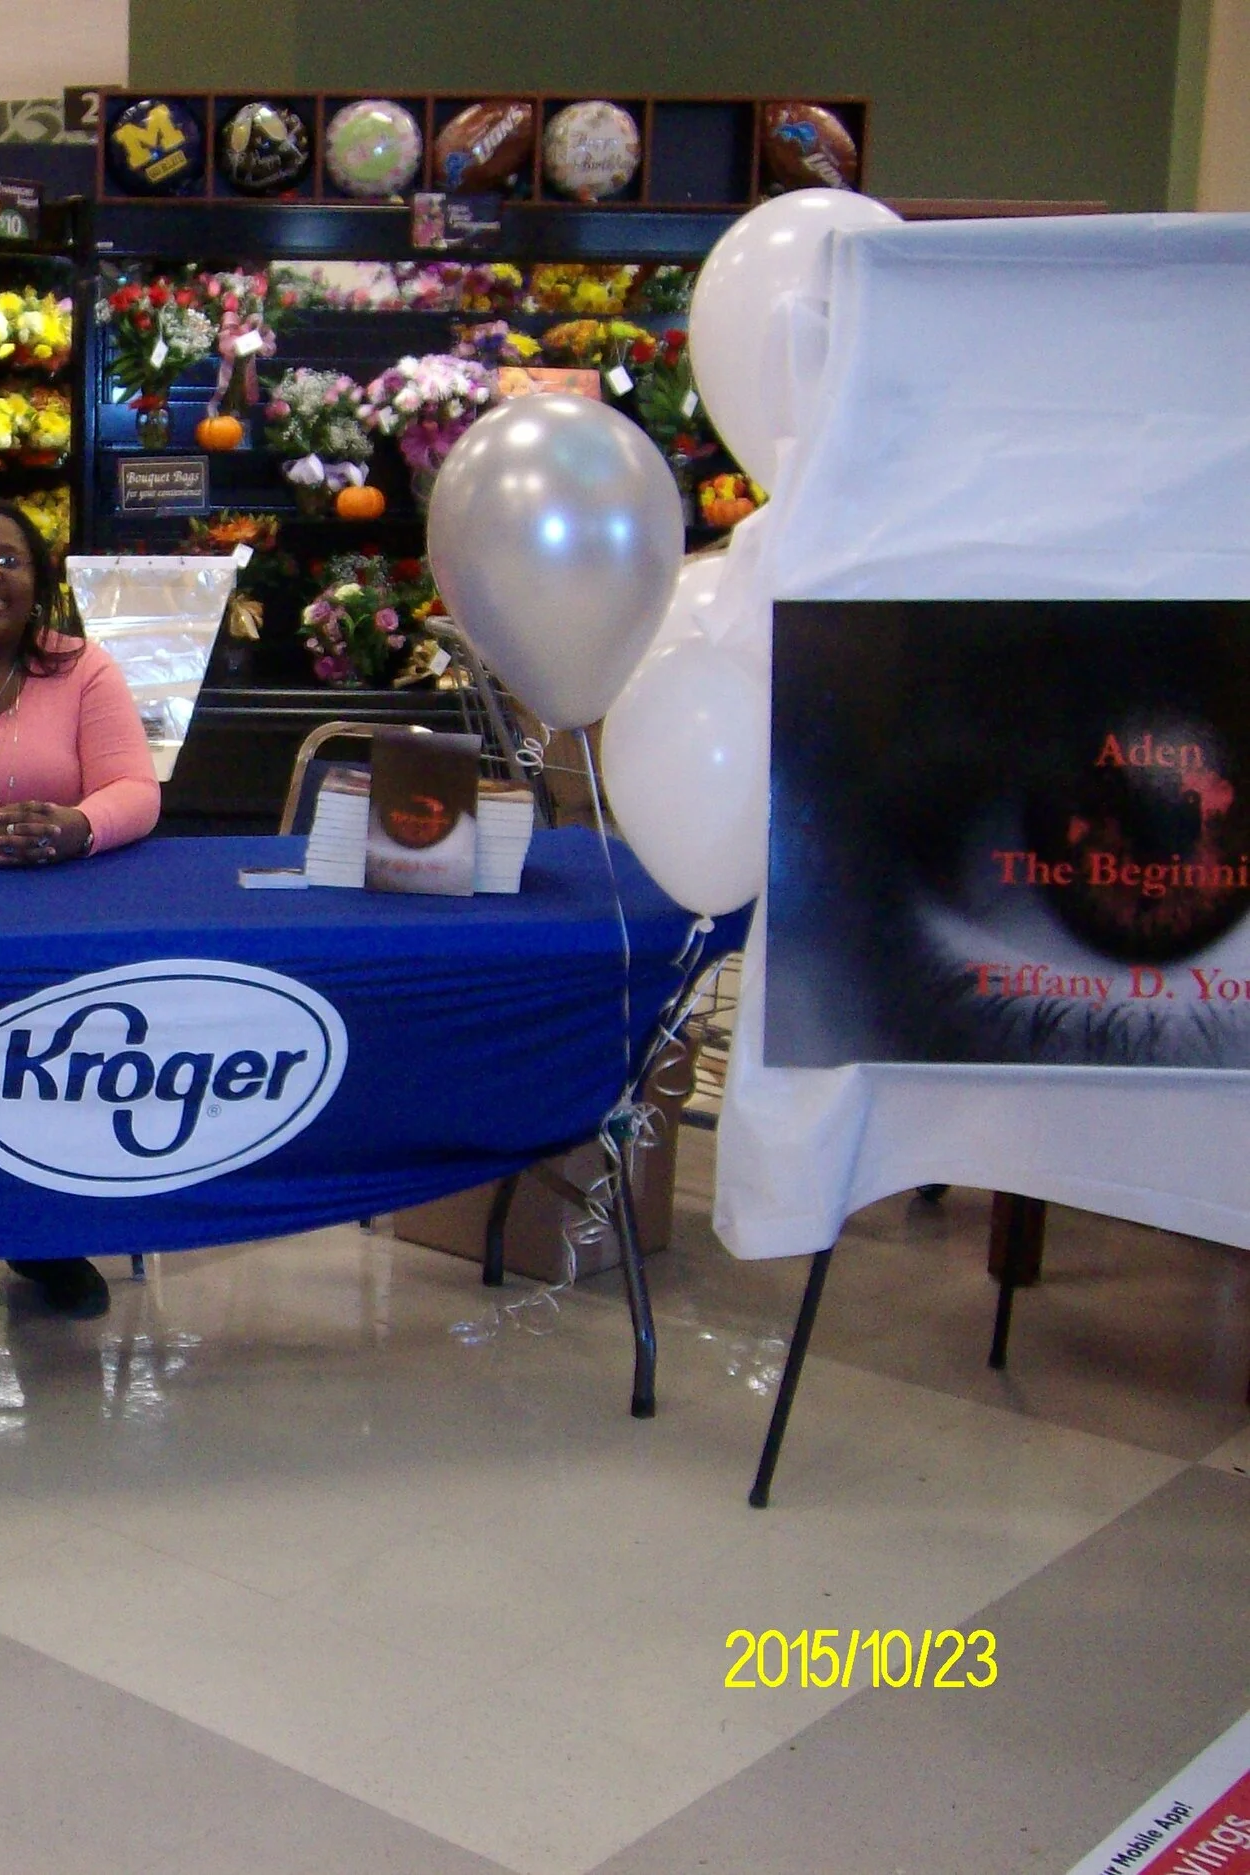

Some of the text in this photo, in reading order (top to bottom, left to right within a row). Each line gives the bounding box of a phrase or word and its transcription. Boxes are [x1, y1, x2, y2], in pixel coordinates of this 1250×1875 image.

[0, 214, 22, 235] $10
[126, 470, 200, 487] Bouquet Bags
[1095, 733, 1204, 769] Aden
[992, 850, 1073, 885] The
[966, 963, 1114, 1010] Tiffany
[1128, 965, 1173, 1000] D.
[2, 1002, 308, 1158] Kroger
[1111, 1830, 1163, 1869] Mobile
[1153, 1800, 1195, 1831] App!
